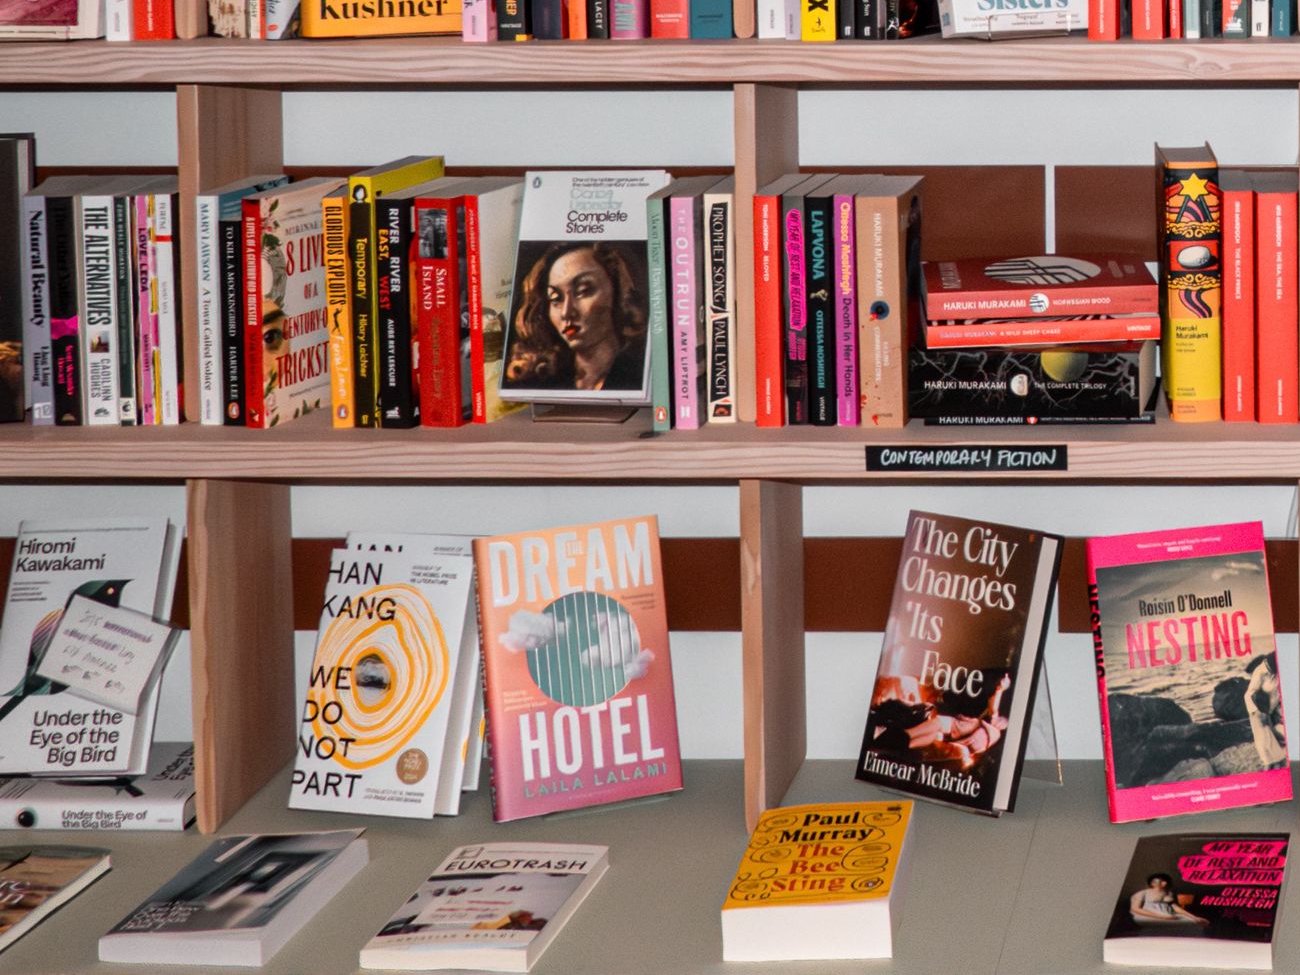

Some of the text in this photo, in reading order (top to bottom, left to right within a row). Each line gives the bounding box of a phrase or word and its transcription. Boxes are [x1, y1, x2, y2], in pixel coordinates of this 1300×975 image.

[567, 210, 628, 223] Complete
[566, 223, 605, 234] Stories
[811, 210, 825, 280] LAPVONA
[84, 205, 113, 326] THE ALTERNATIVES
[423, 266, 432, 310] ISLAND
[436, 268, 447, 307] SMALL
[880, 449, 1057, 465] CONTEMPORARY FICTION
[19, 537, 77, 554] Hiromi
[15, 554, 106, 573] Kawakami
[488, 521, 654, 609] DREAM
[1177, 589, 1233, 613] O'Donnell
[1124, 610, 1252, 669] NESTING
[33, 710, 123, 727] Under the
[30, 728, 120, 746] Eye of the
[518, 694, 665, 782] HOTEL
[47, 745, 116, 765] Big Bird
[802, 811, 860, 826] Paul
[780, 827, 874, 842] Murray
[797, 844, 845, 859] The
[444, 859, 587, 871] EUROTRASH
[789, 860, 840, 875] Bee
[771, 875, 846, 893] Sting
